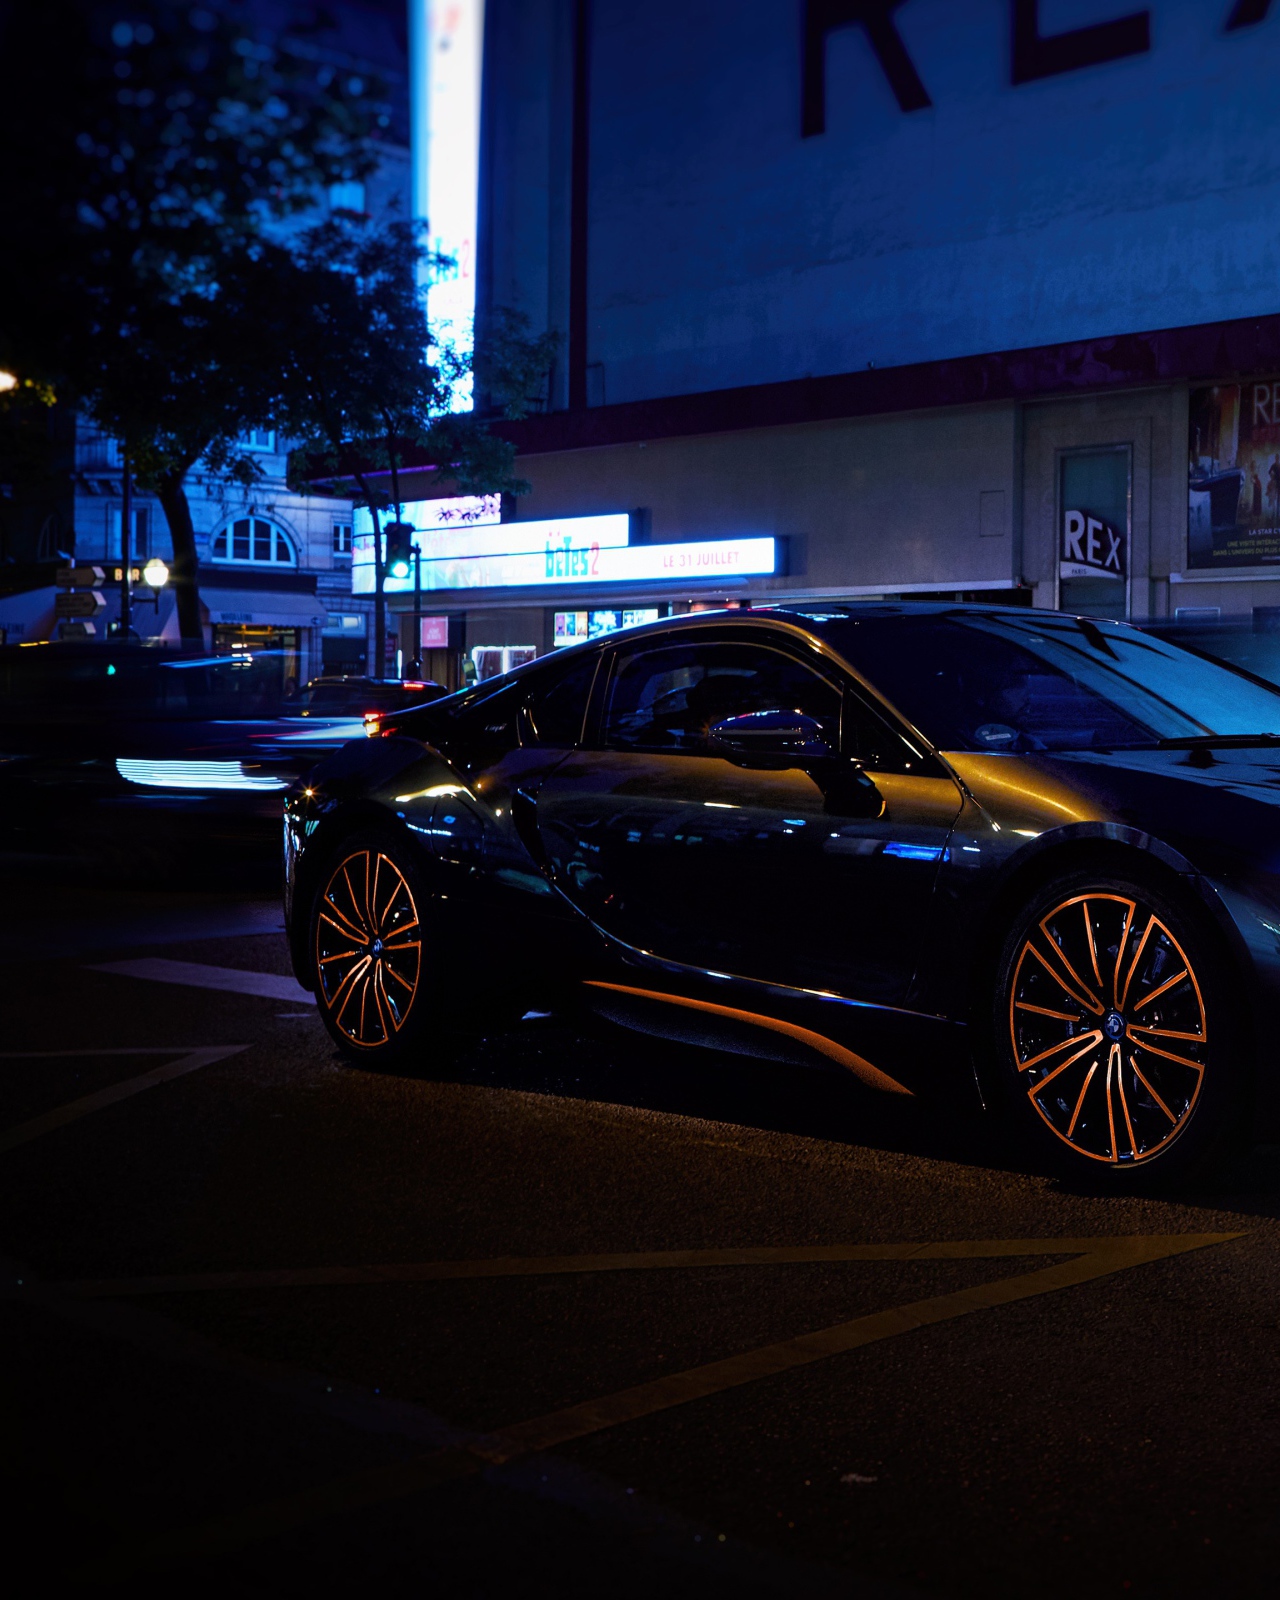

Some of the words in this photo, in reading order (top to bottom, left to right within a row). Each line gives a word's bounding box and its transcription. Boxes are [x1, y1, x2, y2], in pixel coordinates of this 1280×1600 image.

[1064, 510, 1121, 570] REX
[1239, 539, 1255, 547] VISITE
[590, 541, 600, 576] 2
[663, 555, 675, 568] LE
[679, 554, 692, 567] 31
[696, 551, 740, 566] JUILLET
[114, 567, 141, 582] BR
